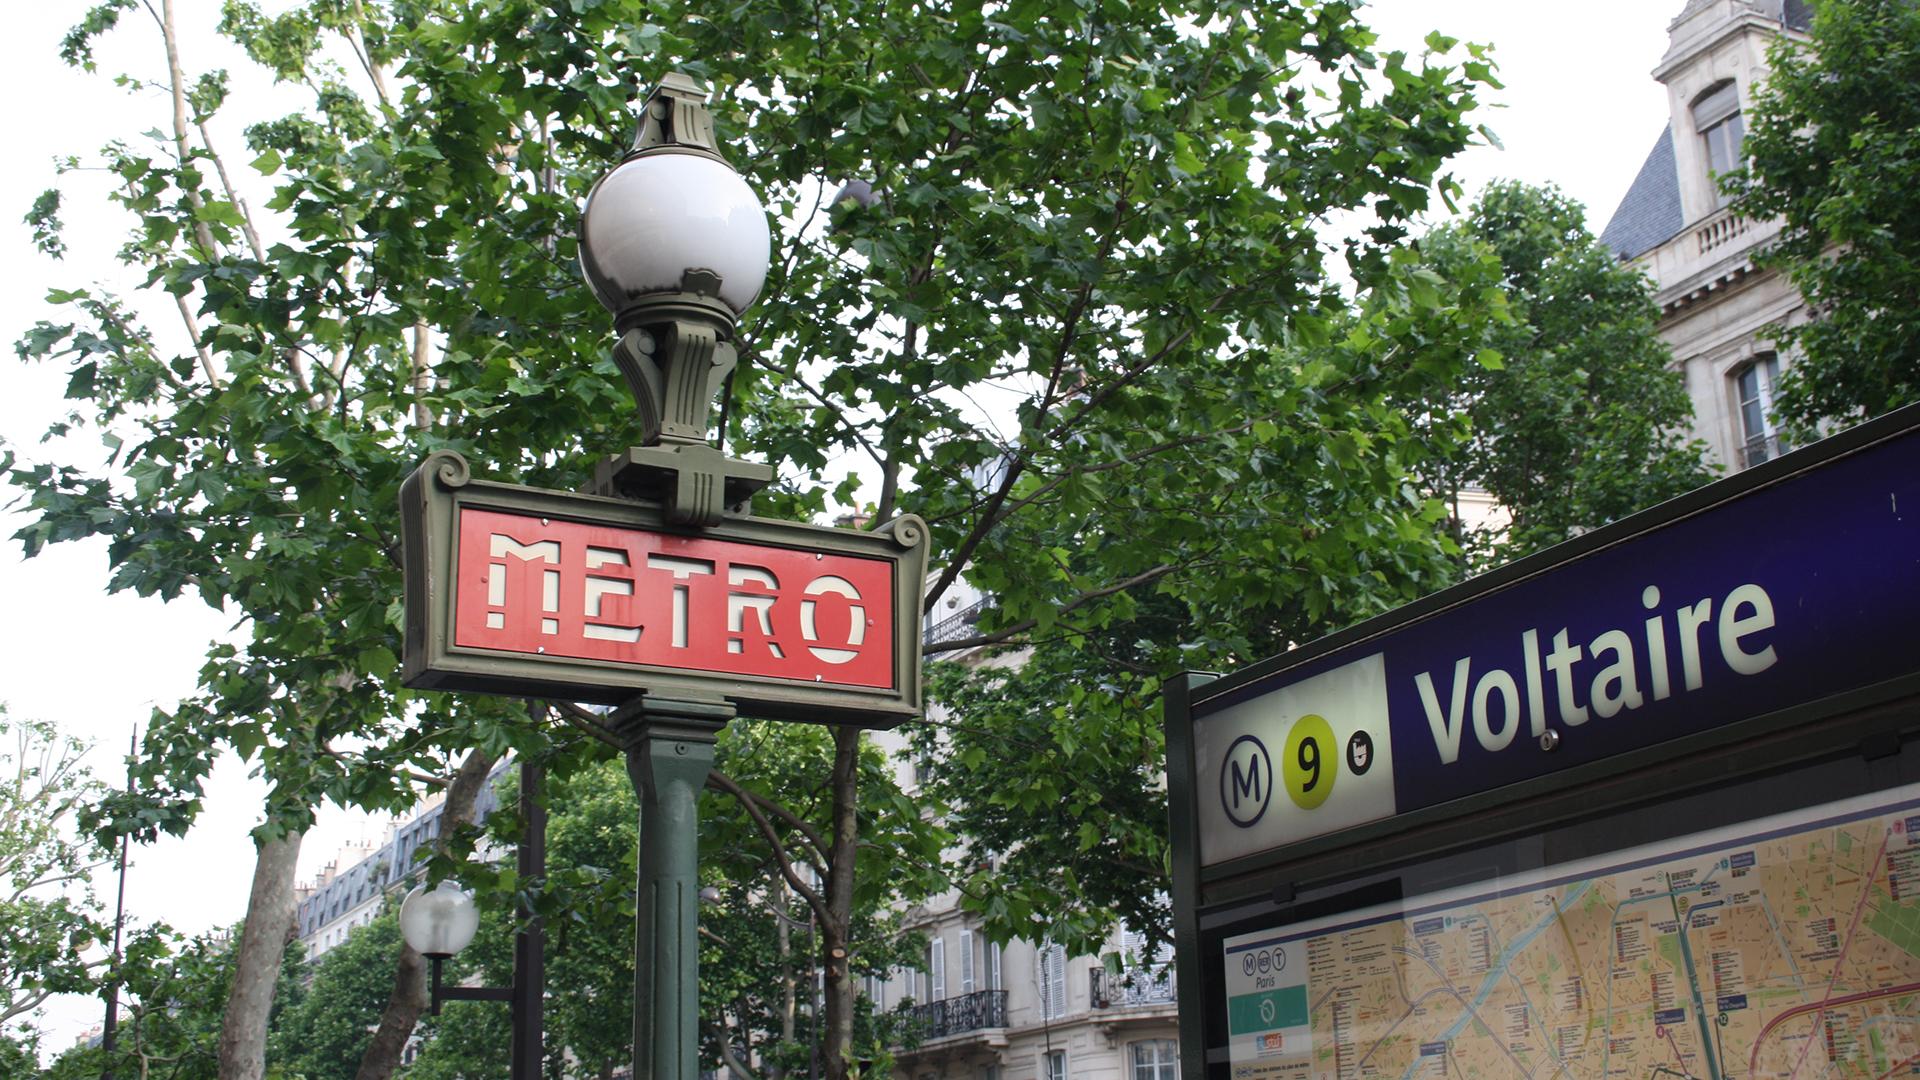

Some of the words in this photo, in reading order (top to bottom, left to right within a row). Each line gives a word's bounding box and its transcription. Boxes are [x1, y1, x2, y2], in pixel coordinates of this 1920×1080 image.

[486, 532, 866, 665] METRO
[1415, 583, 1778, 764] Voltaire
[1296, 736, 1322, 793] 9
[1256, 975, 1275, 989] Paris
